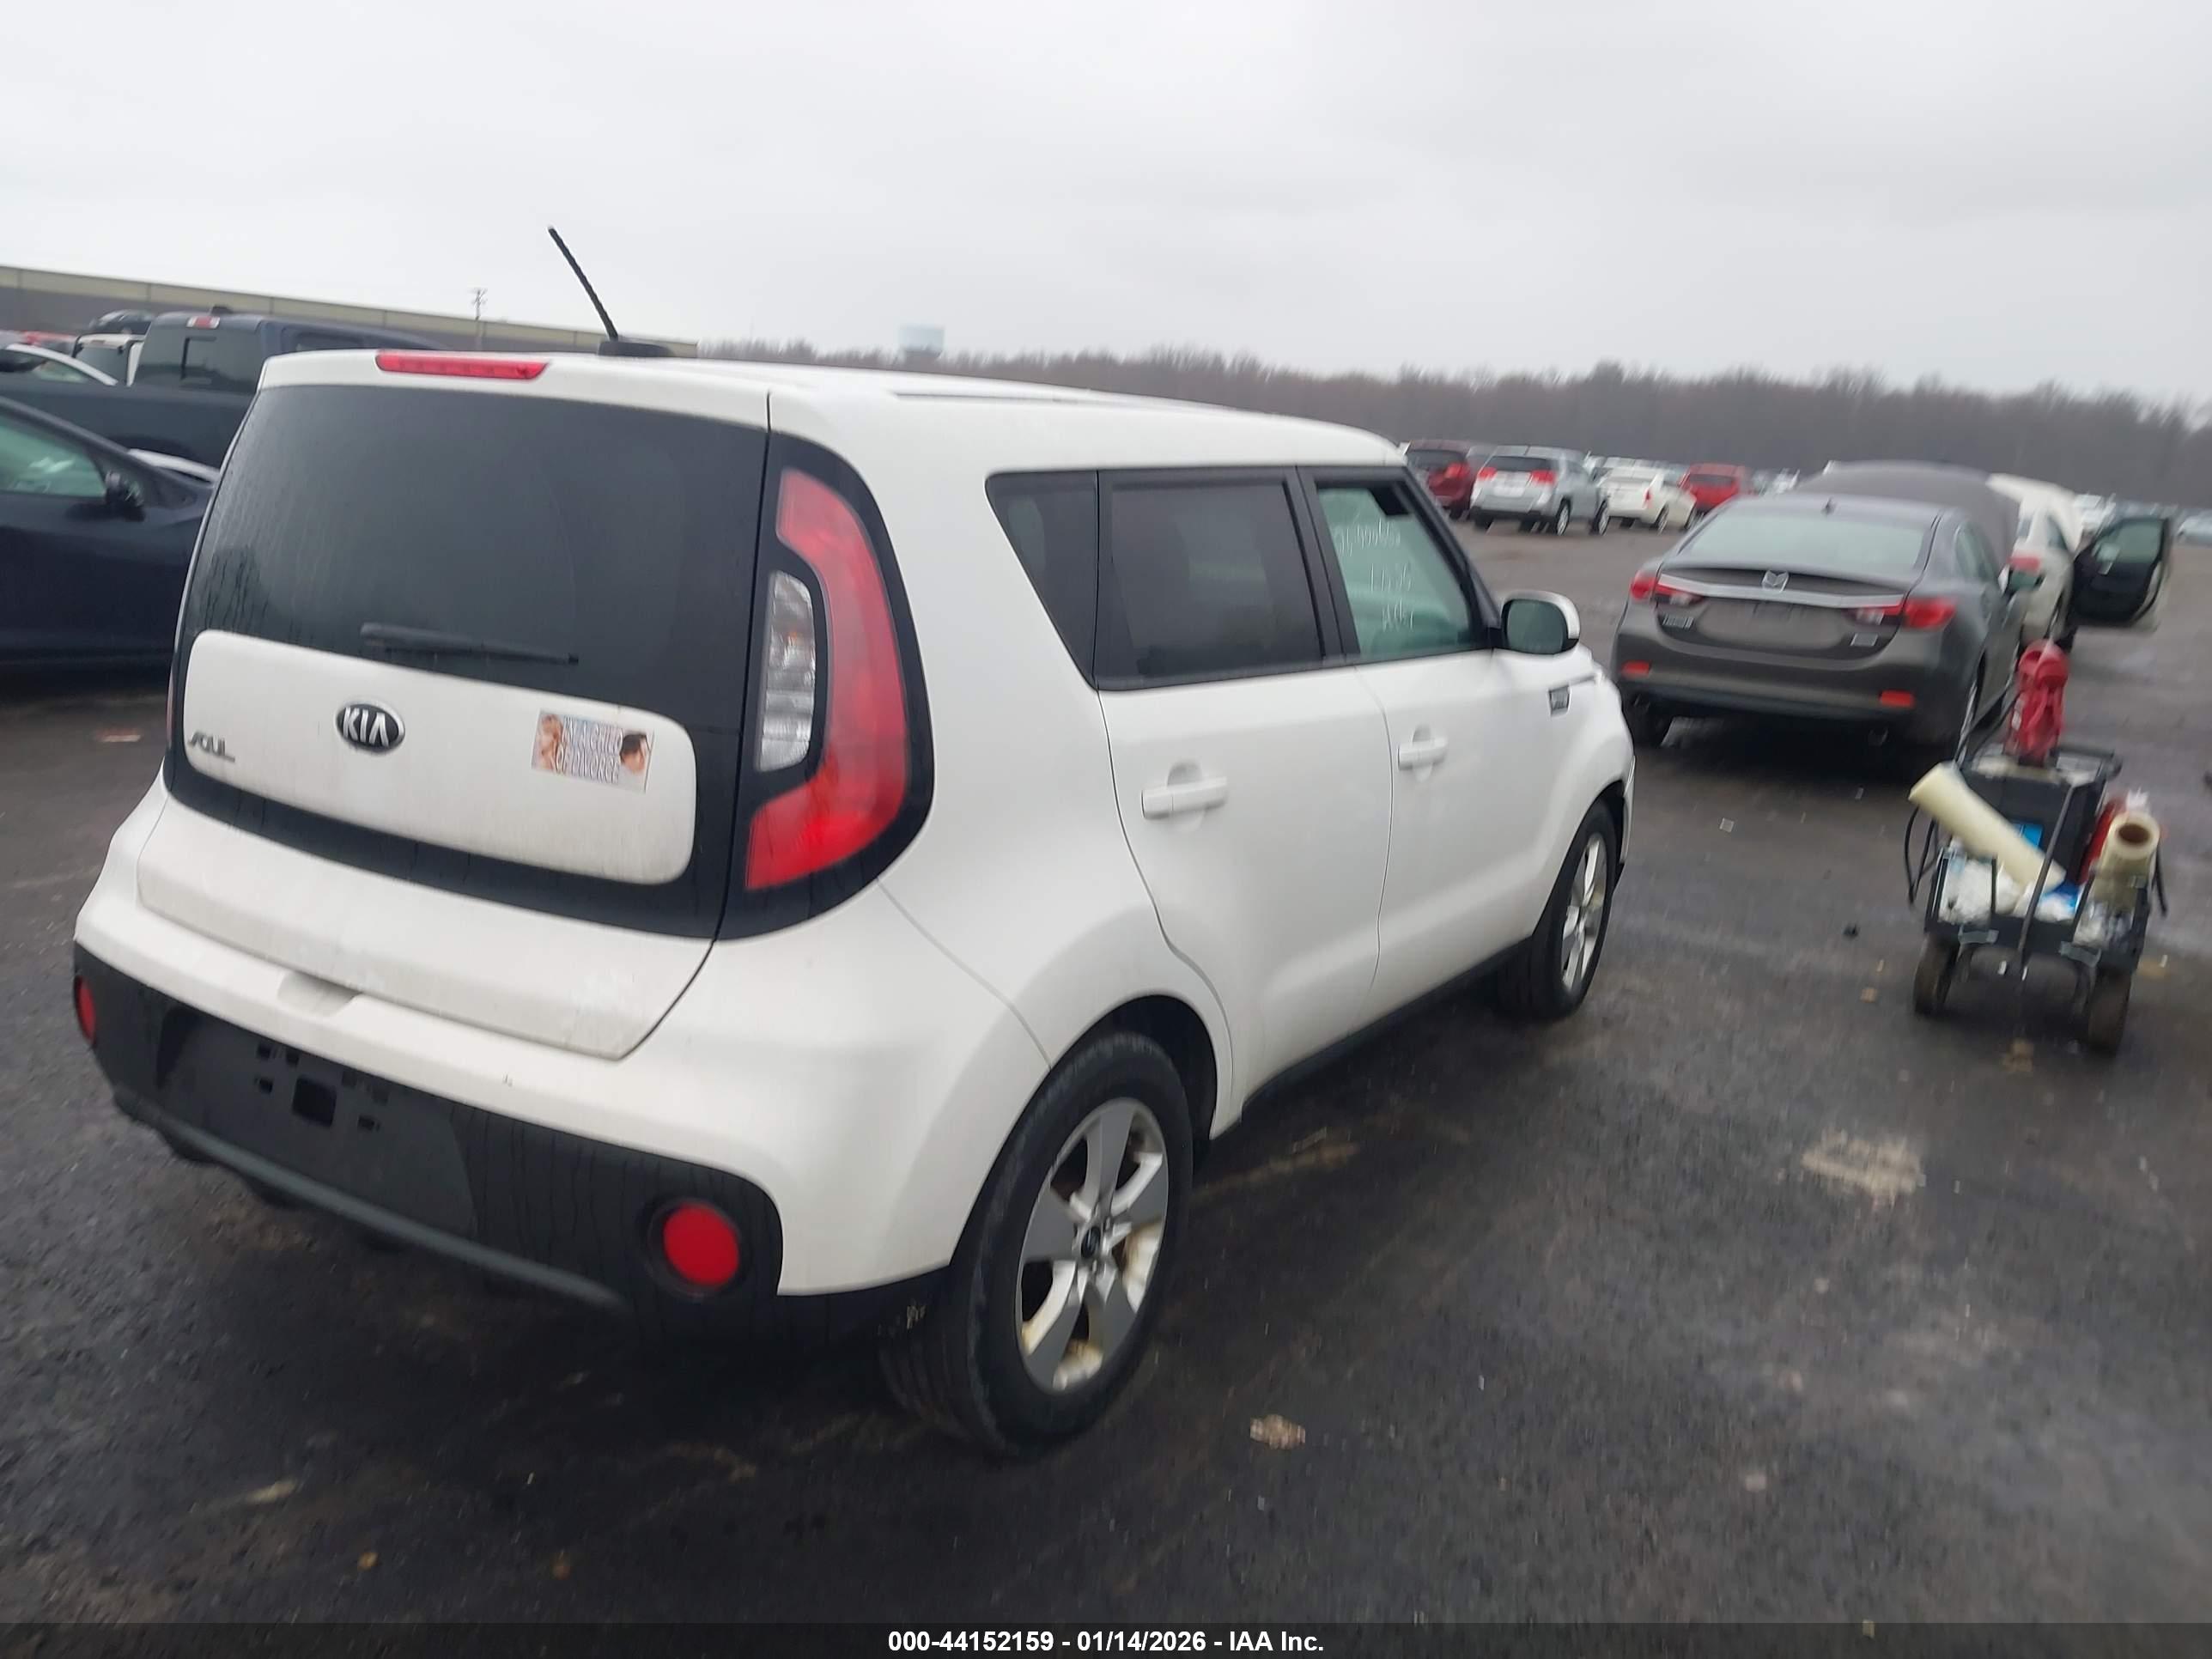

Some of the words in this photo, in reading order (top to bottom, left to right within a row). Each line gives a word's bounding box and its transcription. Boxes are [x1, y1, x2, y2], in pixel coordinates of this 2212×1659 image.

[343, 707, 389, 746] KIA
[555, 742, 569, 775] OF
[570, 747, 620, 784] DIVORCE
